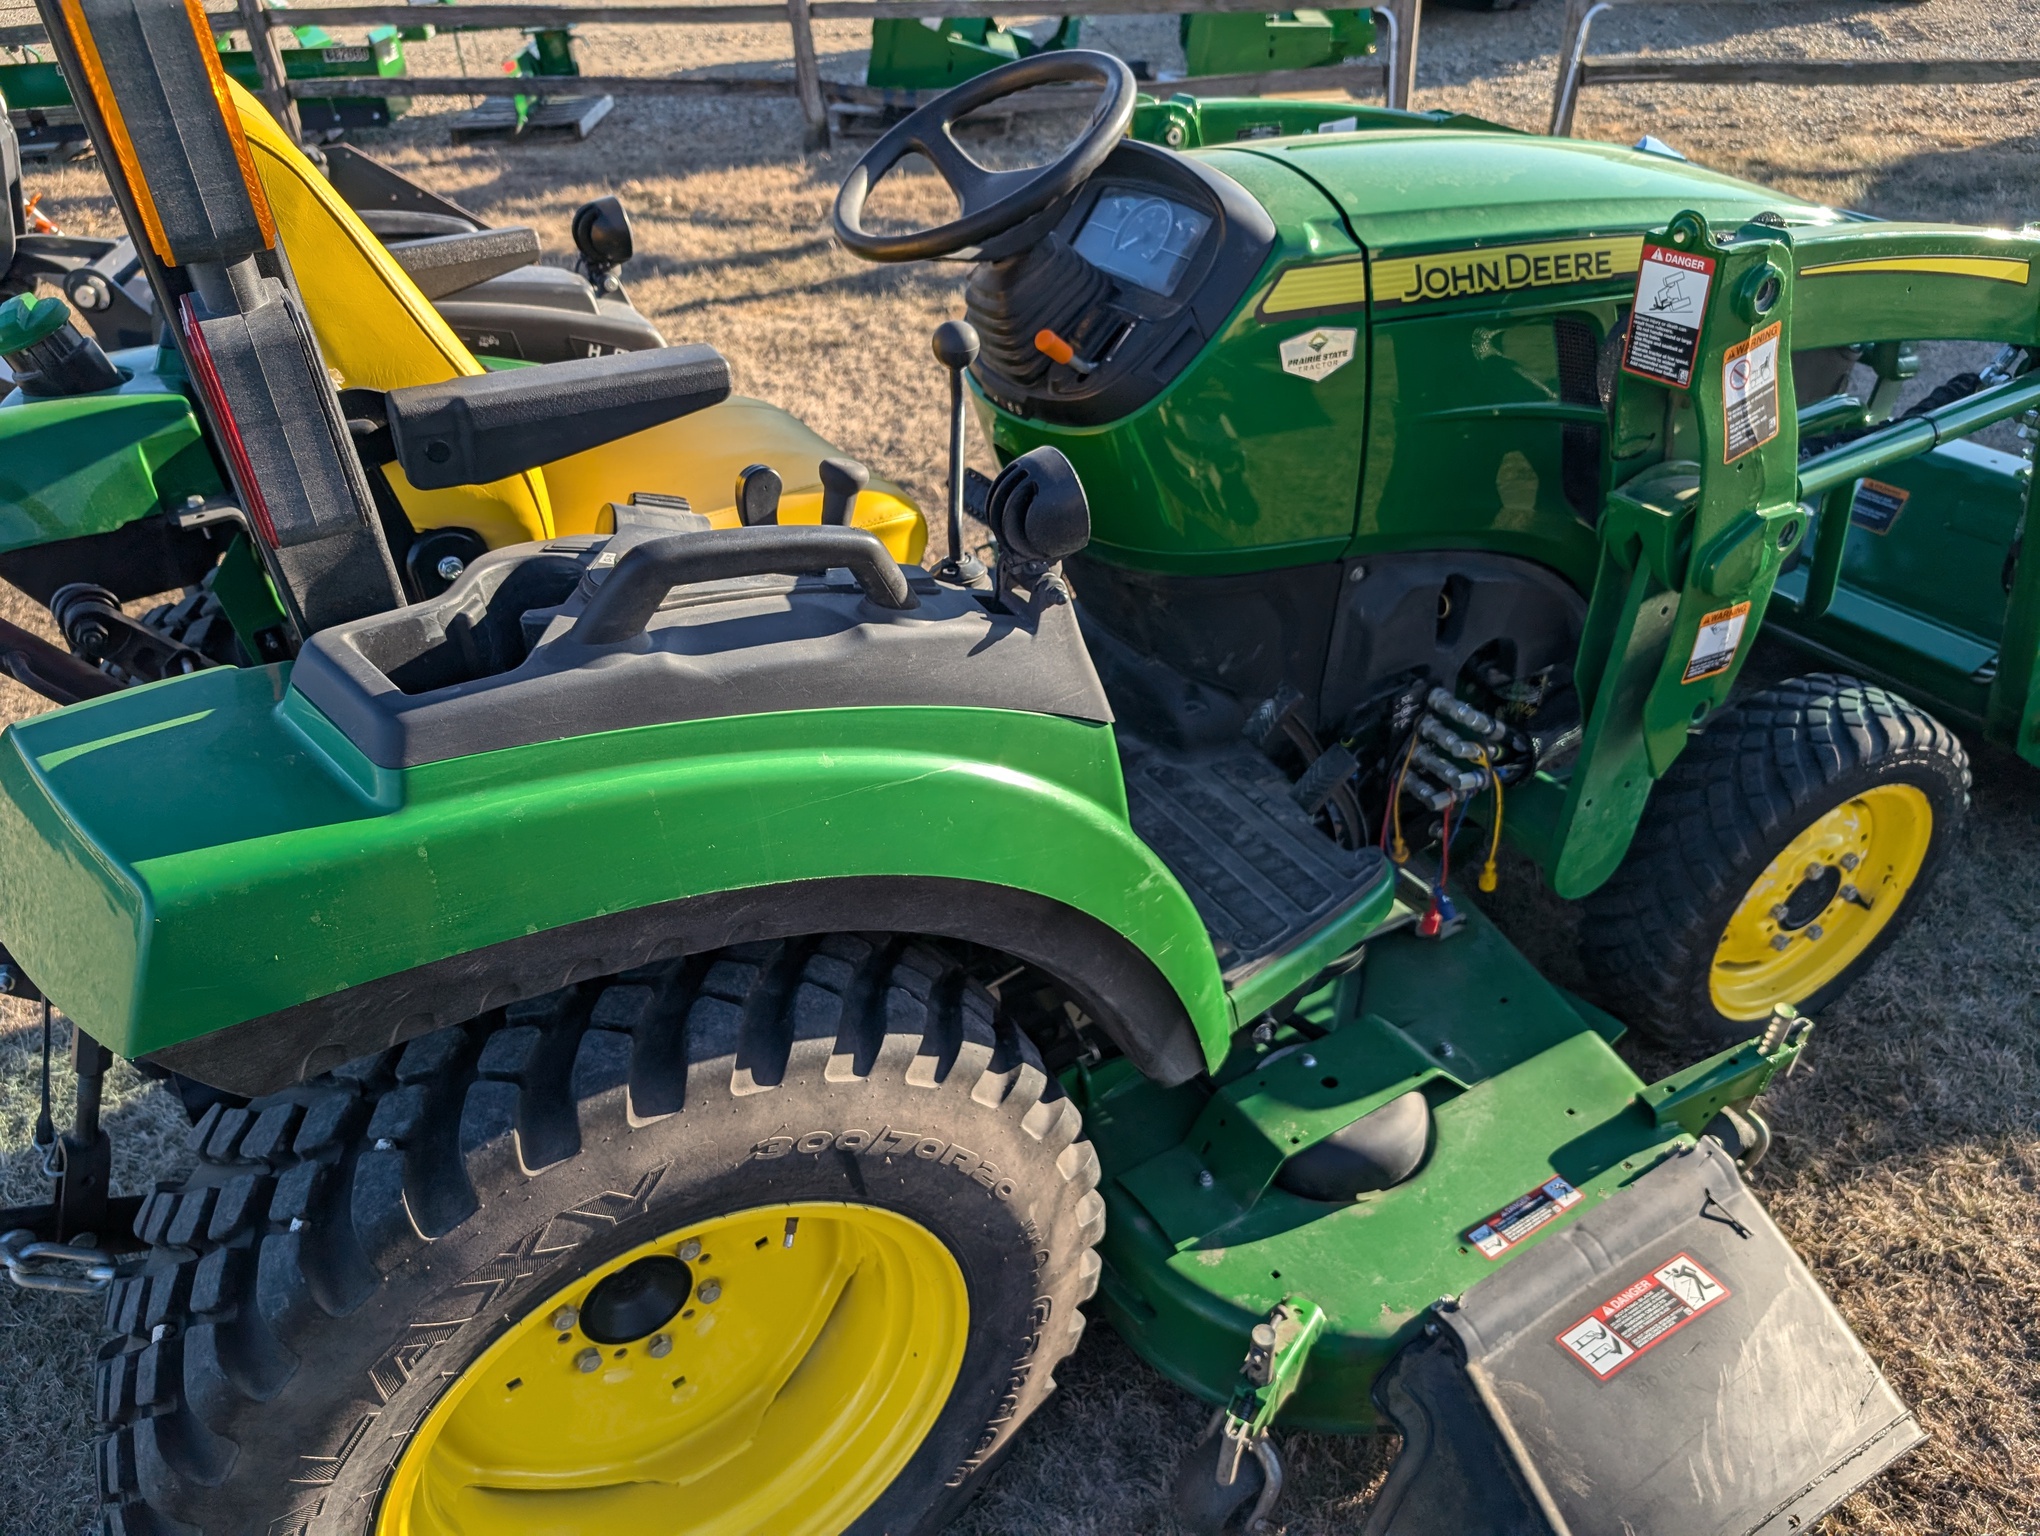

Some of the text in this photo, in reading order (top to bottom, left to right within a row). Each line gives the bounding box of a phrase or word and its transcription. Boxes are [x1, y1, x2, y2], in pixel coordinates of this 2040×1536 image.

[1665, 253, 1705, 271] DANGER
[1404, 251, 1612, 298] JOHN DEERE
[1736, 325, 1778, 355] WARNING
[1288, 350, 1349, 367] PRAIRIE STATE
[1298, 360, 1338, 372] TRACTOR
[1711, 604, 1747, 622] WARNING
[754, 1124, 1018, 1201] 300/70R20
[1609, 1279, 1652, 1308] DANGER
